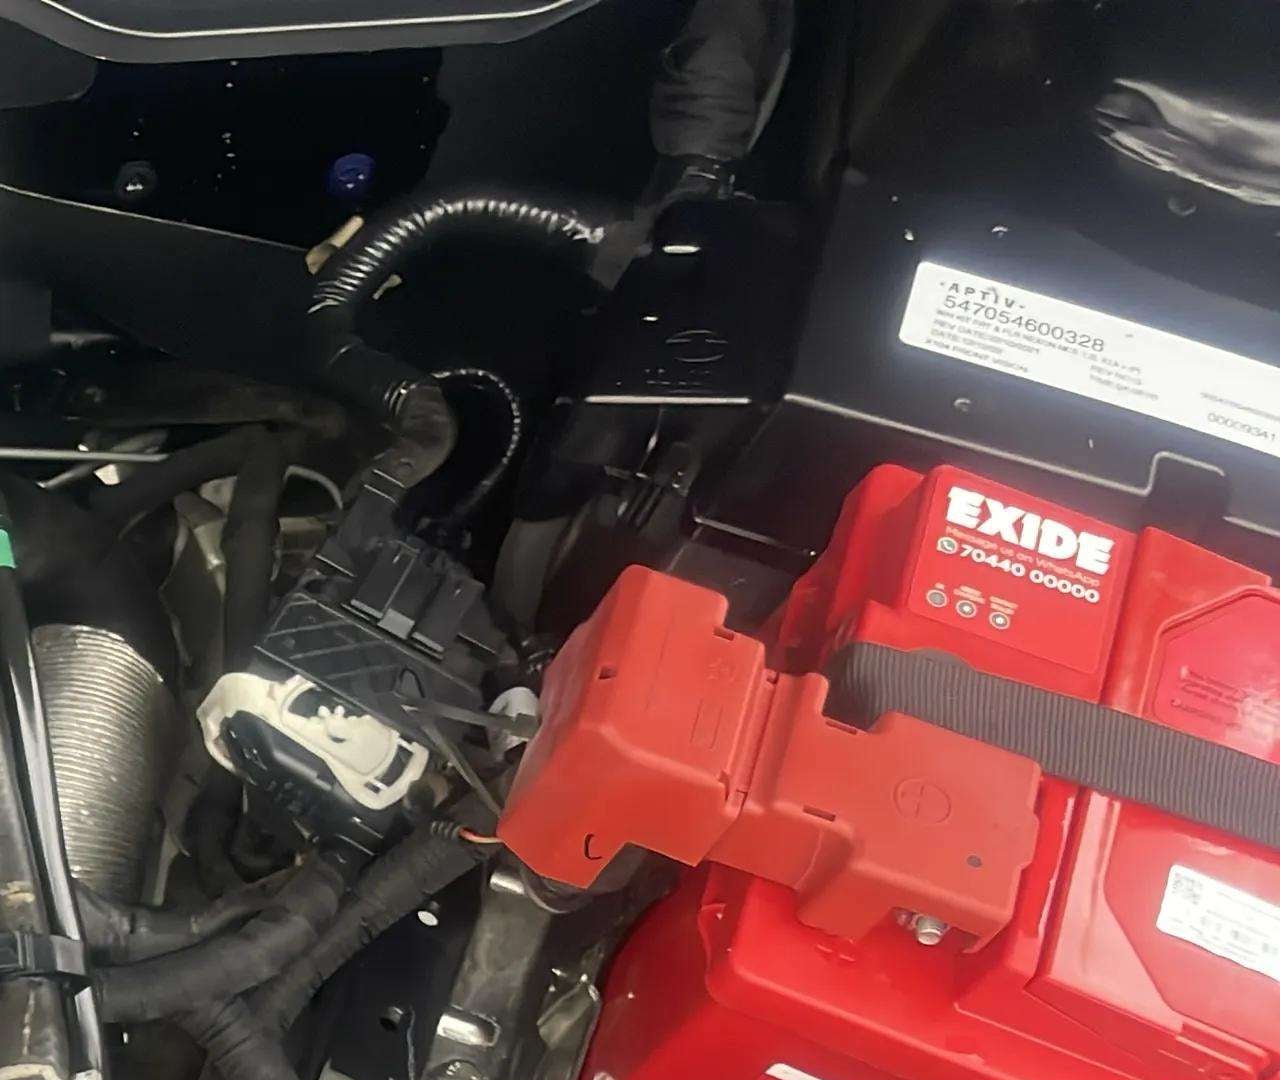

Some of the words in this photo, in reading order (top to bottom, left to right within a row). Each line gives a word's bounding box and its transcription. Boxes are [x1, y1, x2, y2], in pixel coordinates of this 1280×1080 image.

[943, 295, 1105, 352] 547054600328
[947, 486, 1116, 576] EXIDE
[959, 543, 1026, 577] 70440
[1028, 569, 1101, 604] 00000
[1035, 557, 1101, 588] WhatsApp
